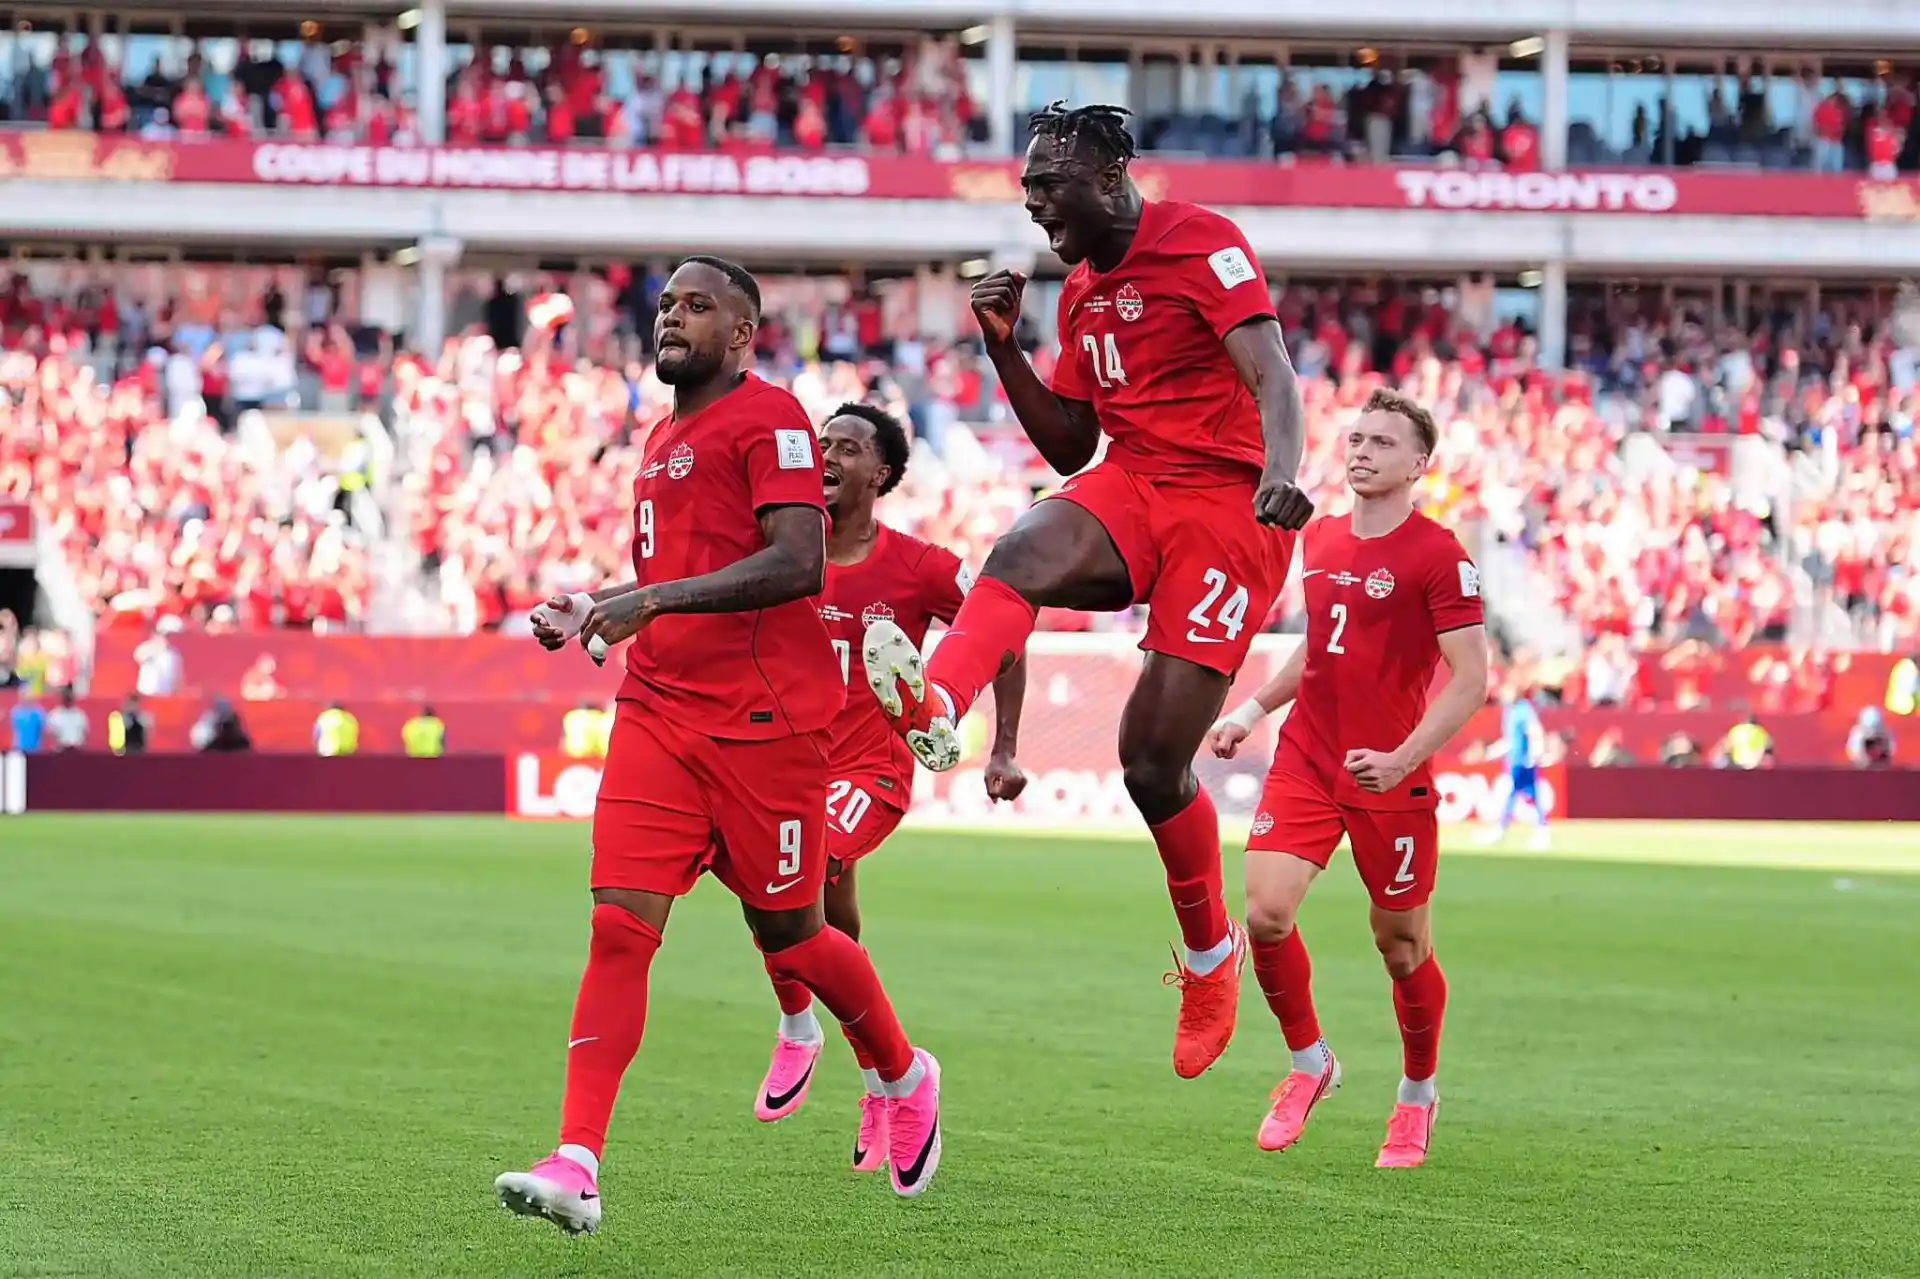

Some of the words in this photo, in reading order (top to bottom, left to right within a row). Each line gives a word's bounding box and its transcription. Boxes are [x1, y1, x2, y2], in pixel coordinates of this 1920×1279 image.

[252, 143, 372, 183] COUPE
[376, 145, 429, 185] DU
[432, 147, 558, 187] MONDE
[562, 151, 608, 189] DE
[612, 152, 660, 190] LA
[661, 153, 740, 192] FIFA
[1396, 170, 1677, 211] TORONTO
[1082, 333, 1129, 387] 24
[639, 499, 654, 558] 9
[1187, 567, 1249, 641] 24
[1327, 603, 1347, 654] 2
[826, 780, 872, 834] 20
[779, 819, 801, 876] 9
[1395, 836, 1414, 882] 2
